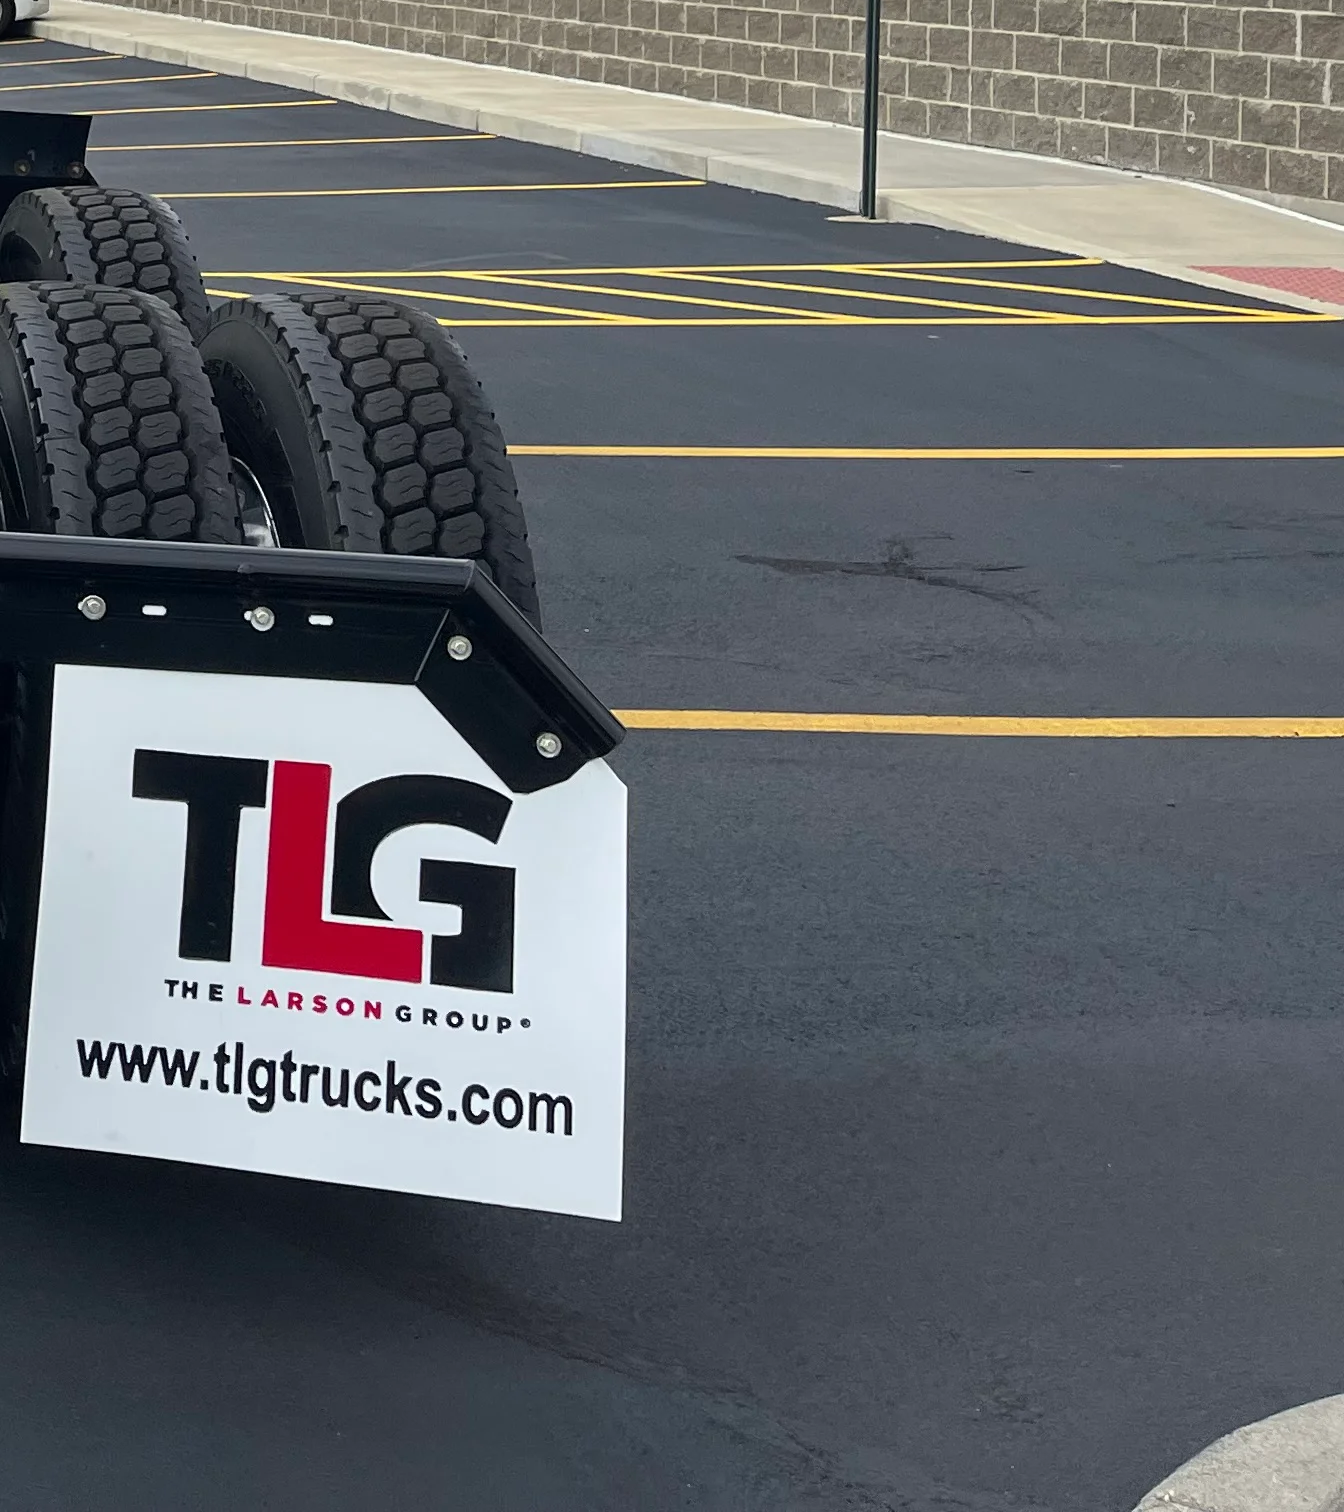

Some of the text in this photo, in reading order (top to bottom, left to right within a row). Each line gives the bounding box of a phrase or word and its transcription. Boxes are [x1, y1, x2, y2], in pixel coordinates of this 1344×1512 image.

[131, 748, 517, 995] TLG
[164, 978, 224, 1003] THE
[237, 986, 383, 1020] LARSON
[77, 1038, 574, 1137] www.tlgtrucks.com
